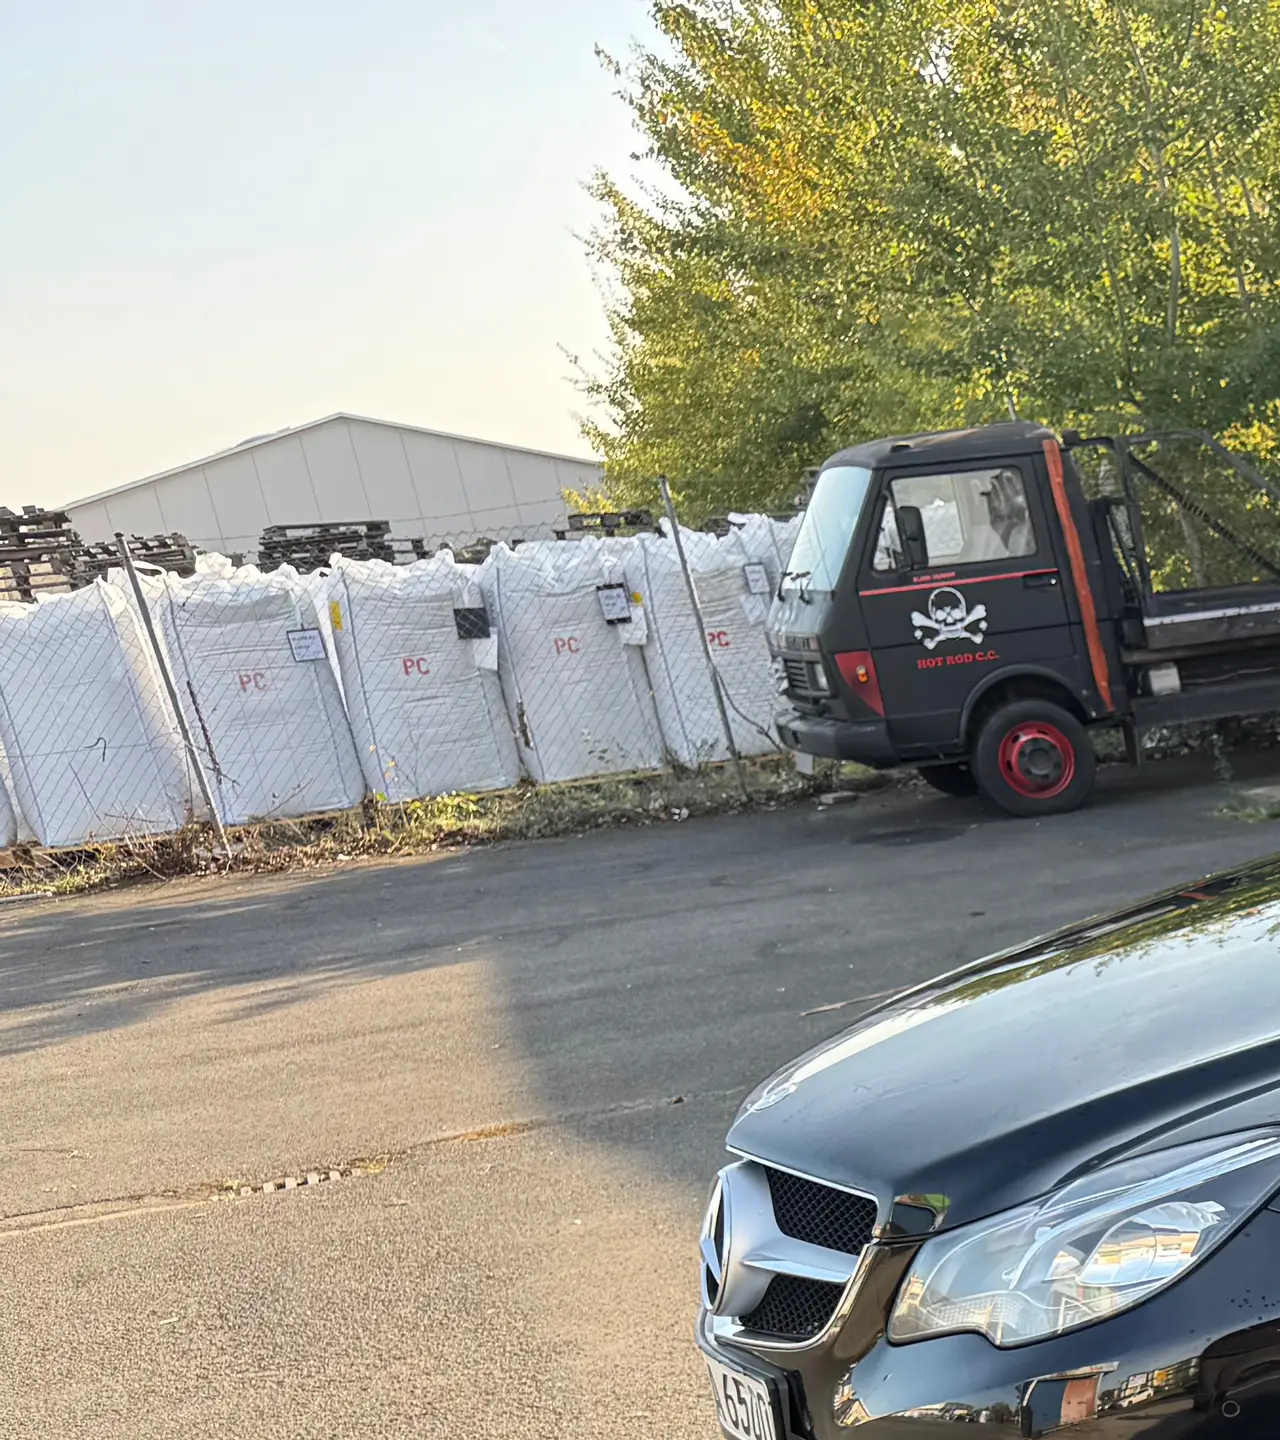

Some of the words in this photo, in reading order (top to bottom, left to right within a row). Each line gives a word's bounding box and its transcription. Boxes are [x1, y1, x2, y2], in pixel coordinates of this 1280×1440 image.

[553, 636, 581, 656] PC
[402, 657, 431, 676] PC
[917, 656, 944, 669] HOT
[946, 653, 973, 666] ROD
[975, 650, 1000, 661] C.C.
[238, 671, 267, 692] PC
